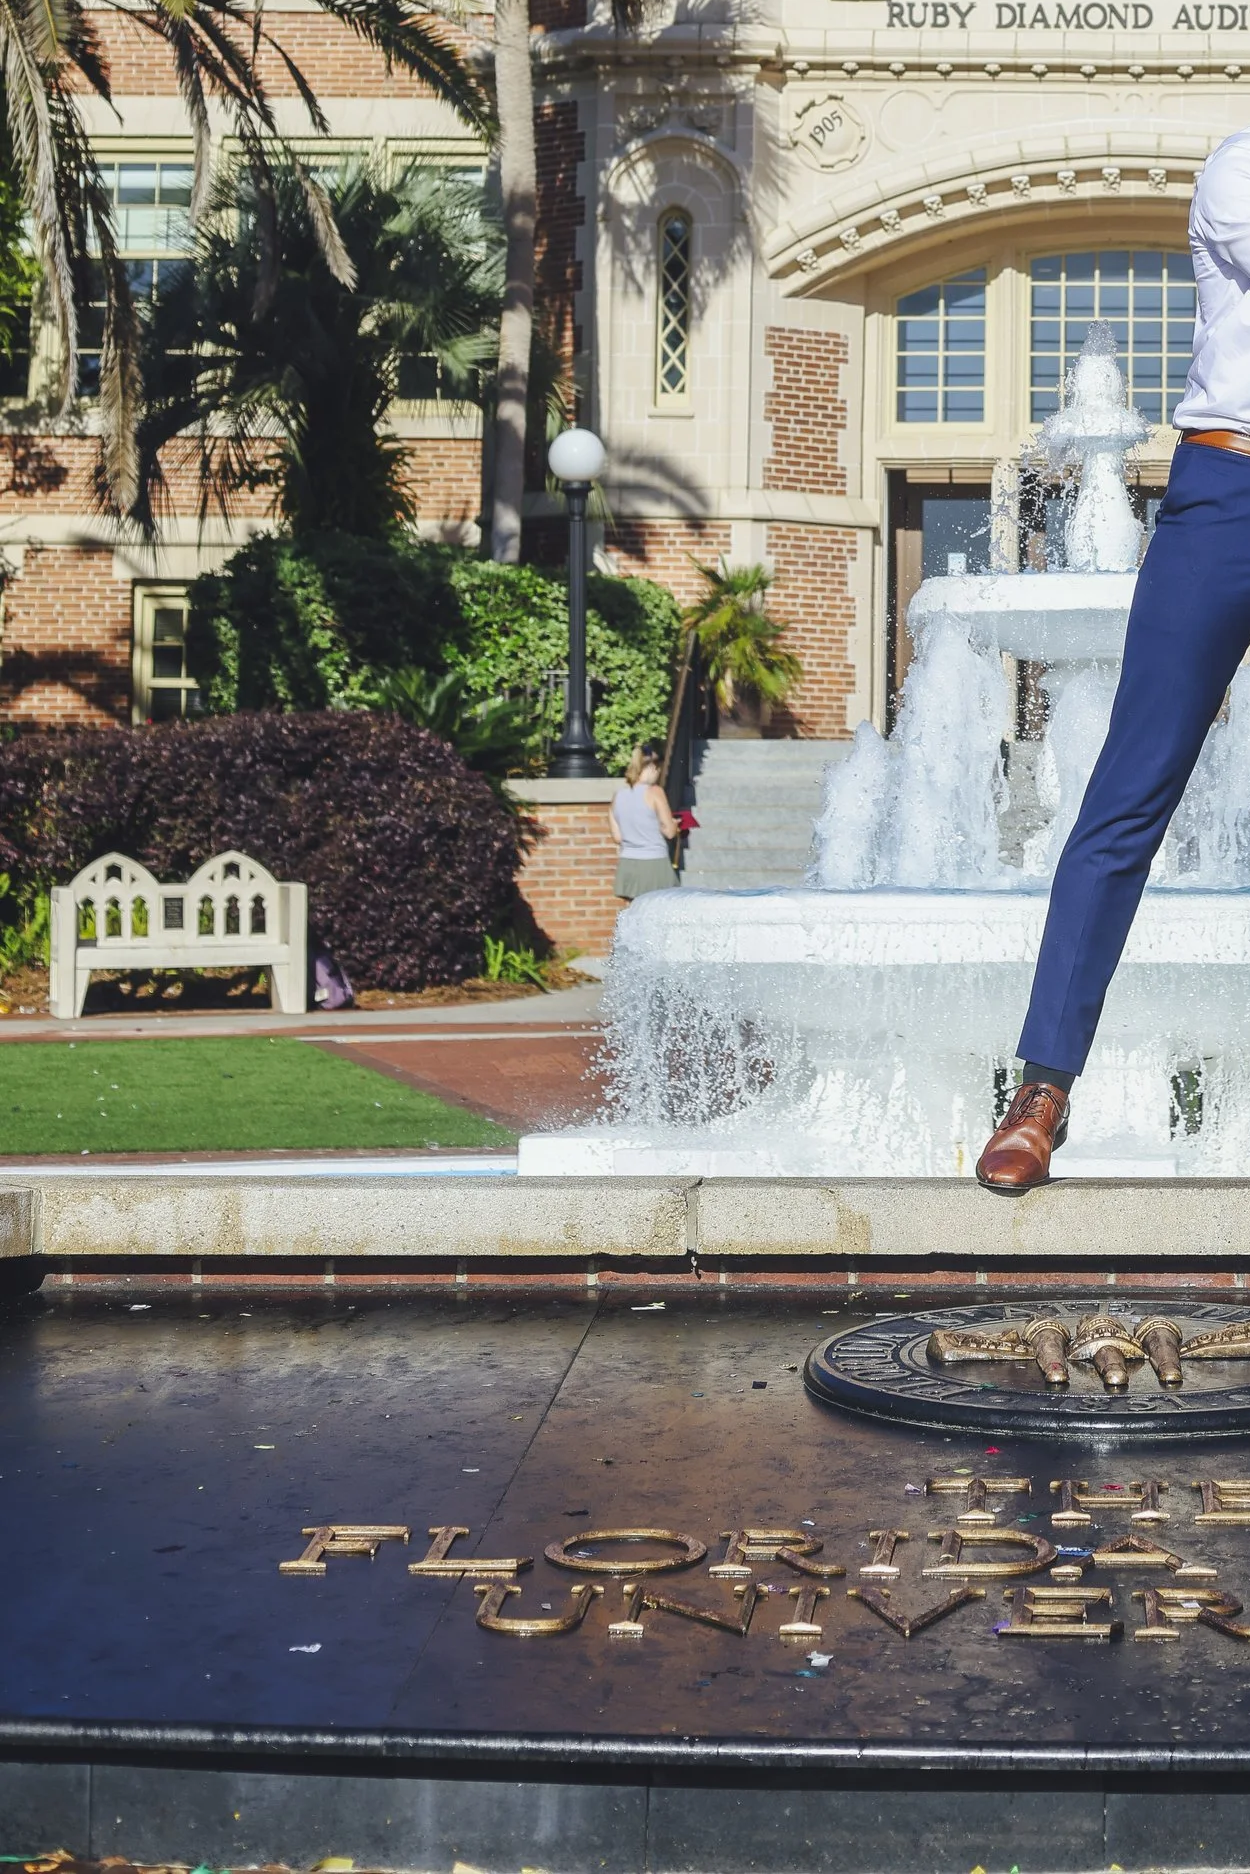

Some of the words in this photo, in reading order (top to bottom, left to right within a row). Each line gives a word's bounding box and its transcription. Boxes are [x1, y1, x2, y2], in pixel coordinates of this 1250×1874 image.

[886, 1, 977, 28] RUBY
[995, 3, 1153, 30] DIAMOND
[808, 110, 843, 149] 1905
[278, 1525, 1218, 1577] FLORIDA
